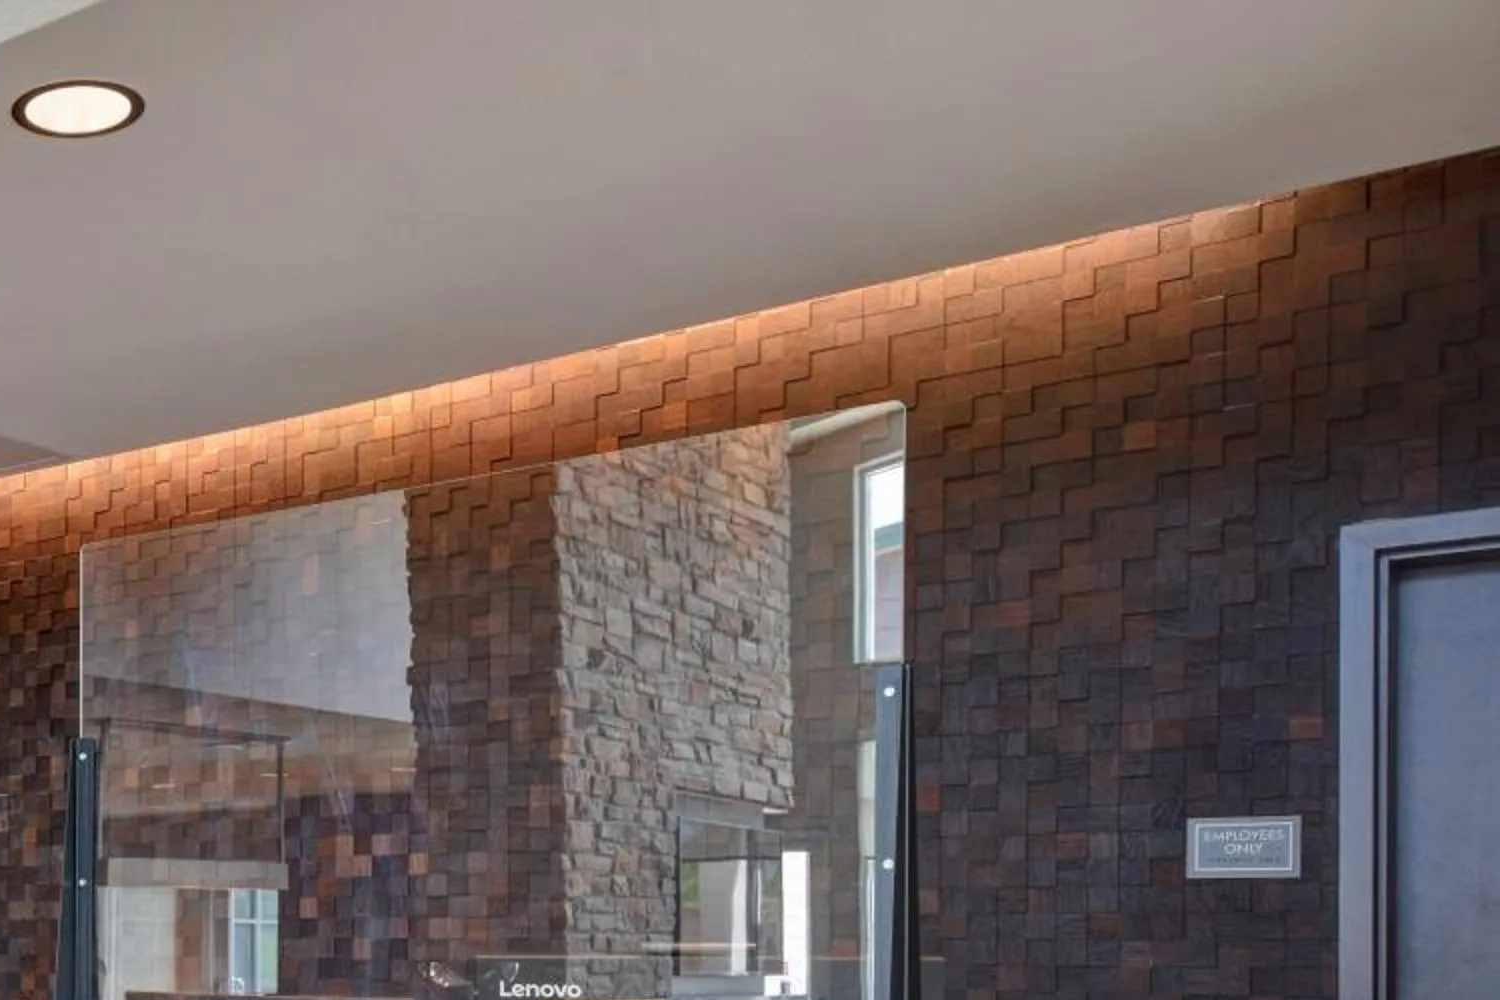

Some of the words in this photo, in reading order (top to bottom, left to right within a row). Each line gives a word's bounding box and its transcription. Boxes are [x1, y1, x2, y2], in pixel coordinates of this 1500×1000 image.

[1203, 829, 1286, 842] EMPLOYEES
[1223, 843, 1264, 855] ONLY
[499, 979, 582, 998] Lenovo
